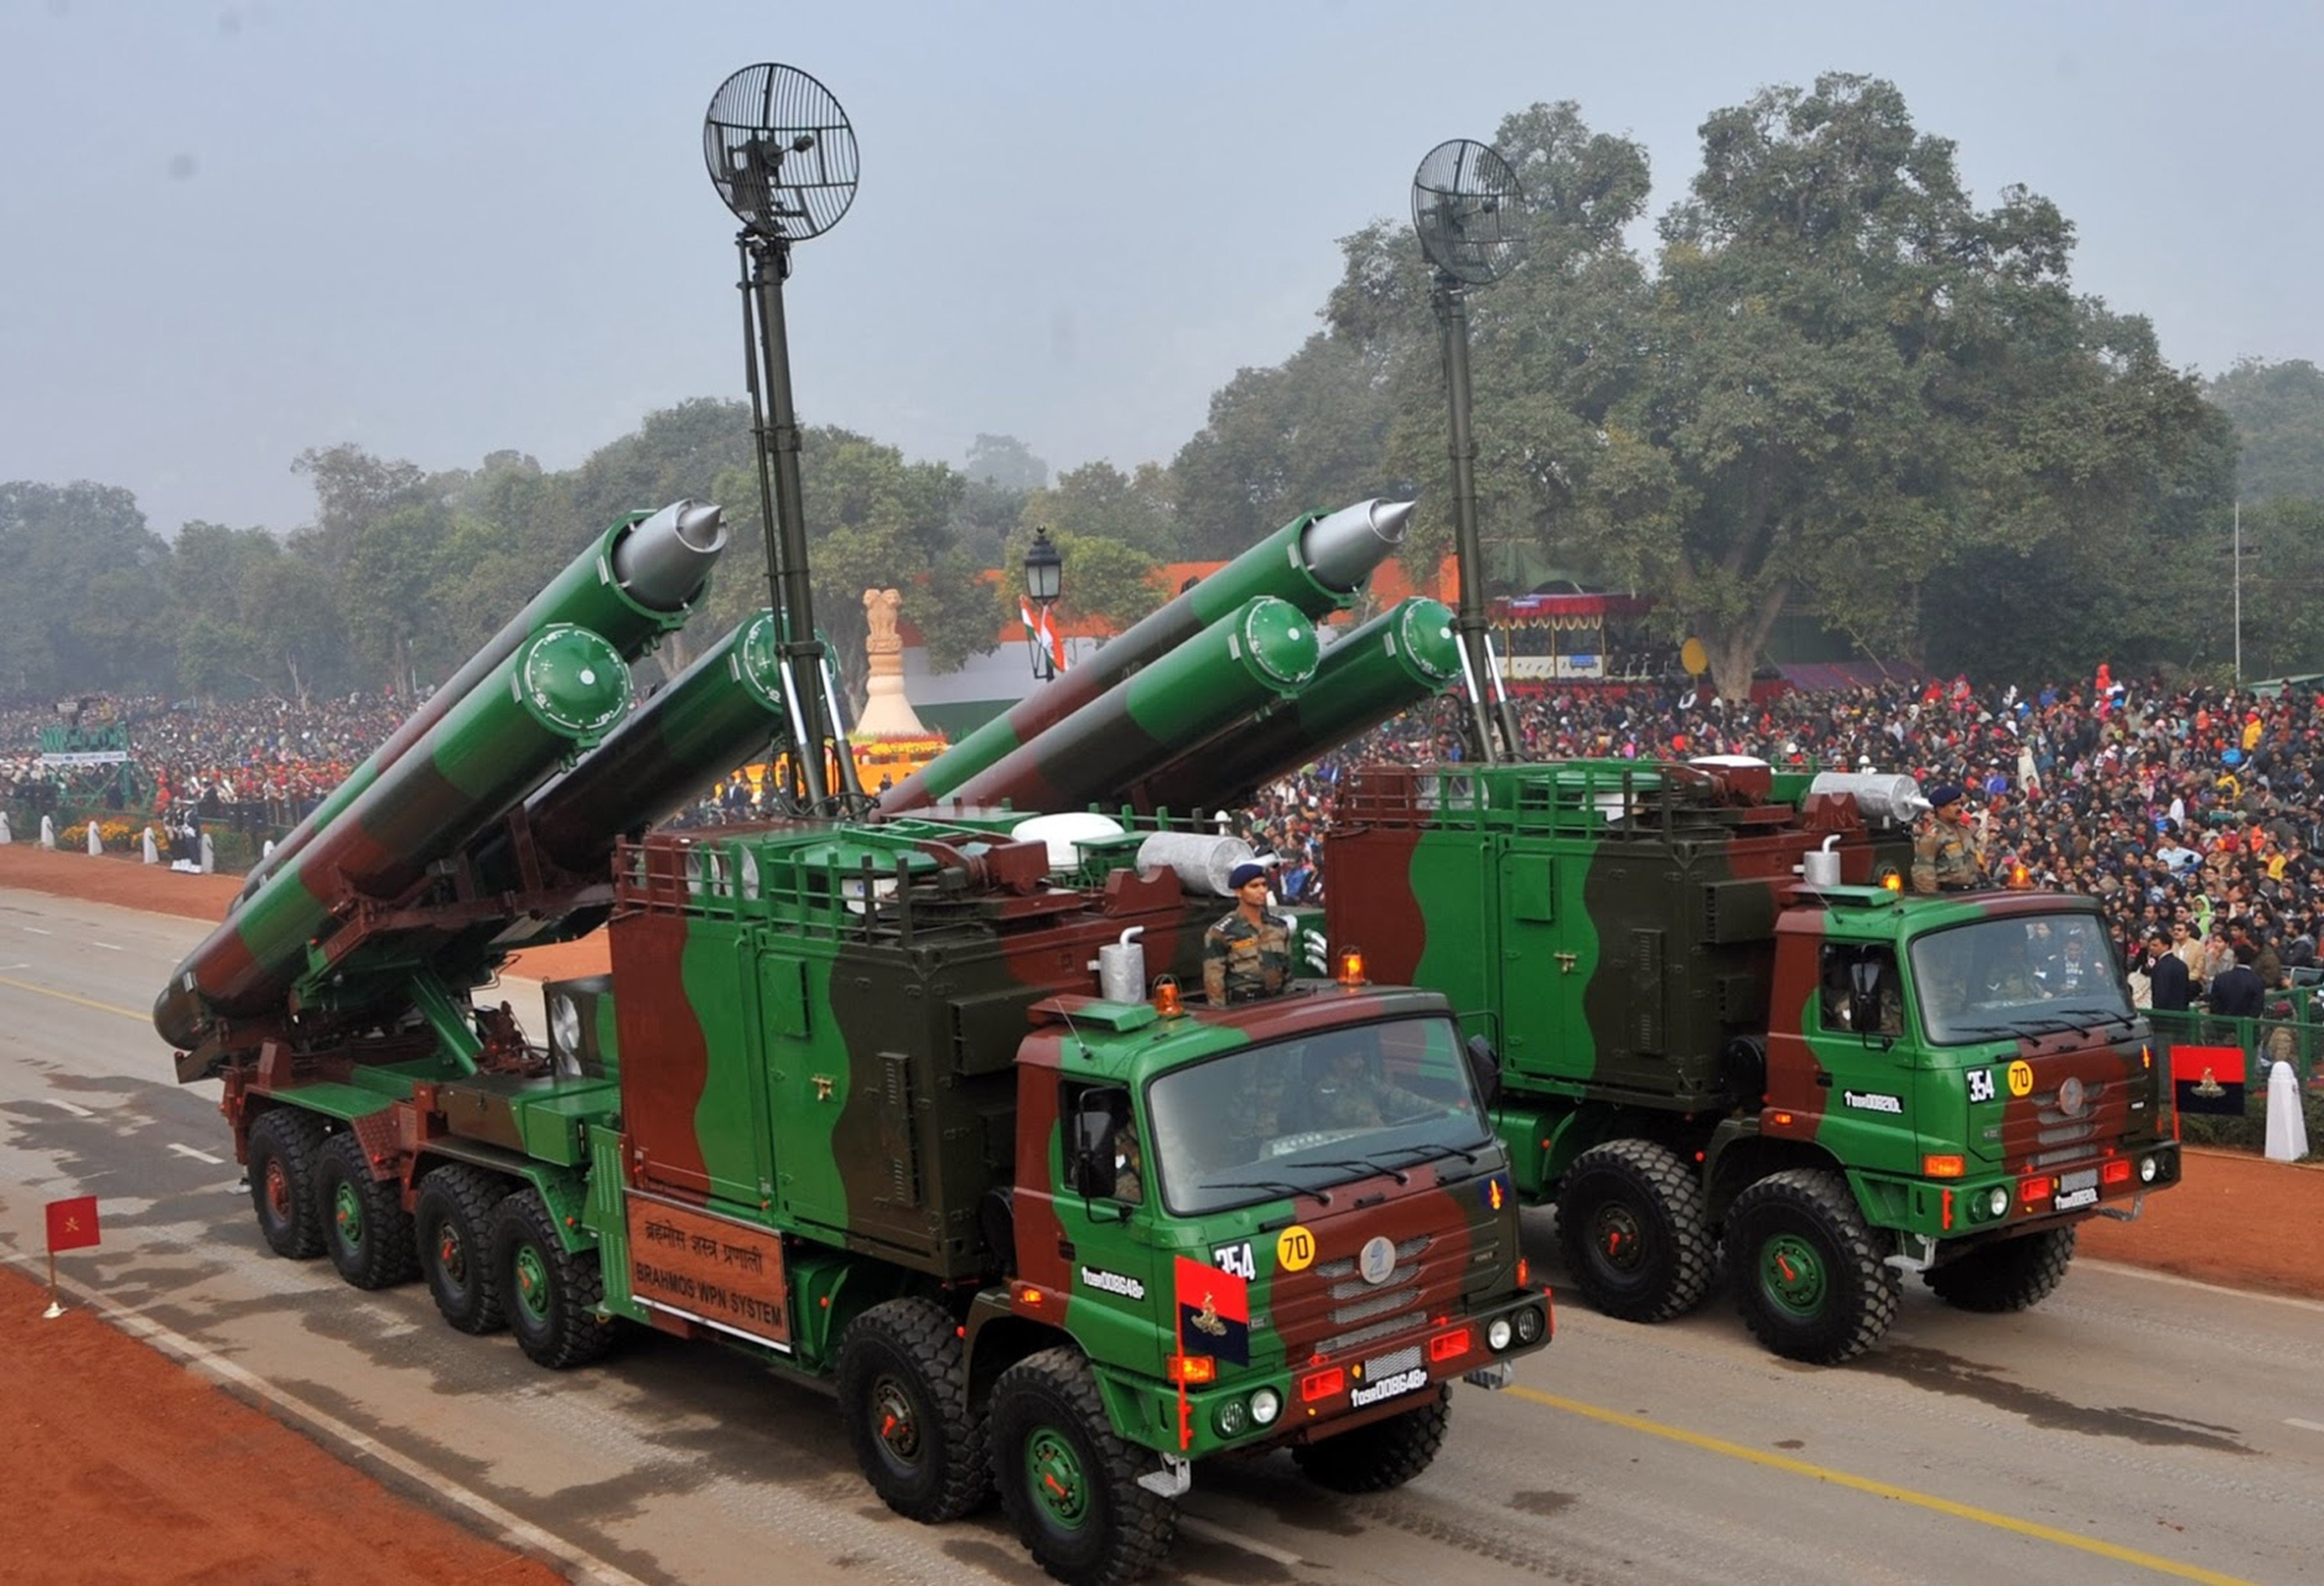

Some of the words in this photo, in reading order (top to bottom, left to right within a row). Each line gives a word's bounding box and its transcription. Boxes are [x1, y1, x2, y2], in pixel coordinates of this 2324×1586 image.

[1967, 1070, 1994, 1101] 354
[2012, 1068, 2029, 1089] 70
[1283, 1235, 1308, 1264] 70
[636, 1262, 695, 1298] BRAHMOS
[699, 1282, 726, 1309] WPN
[731, 1293, 782, 1328] SYSTEM
